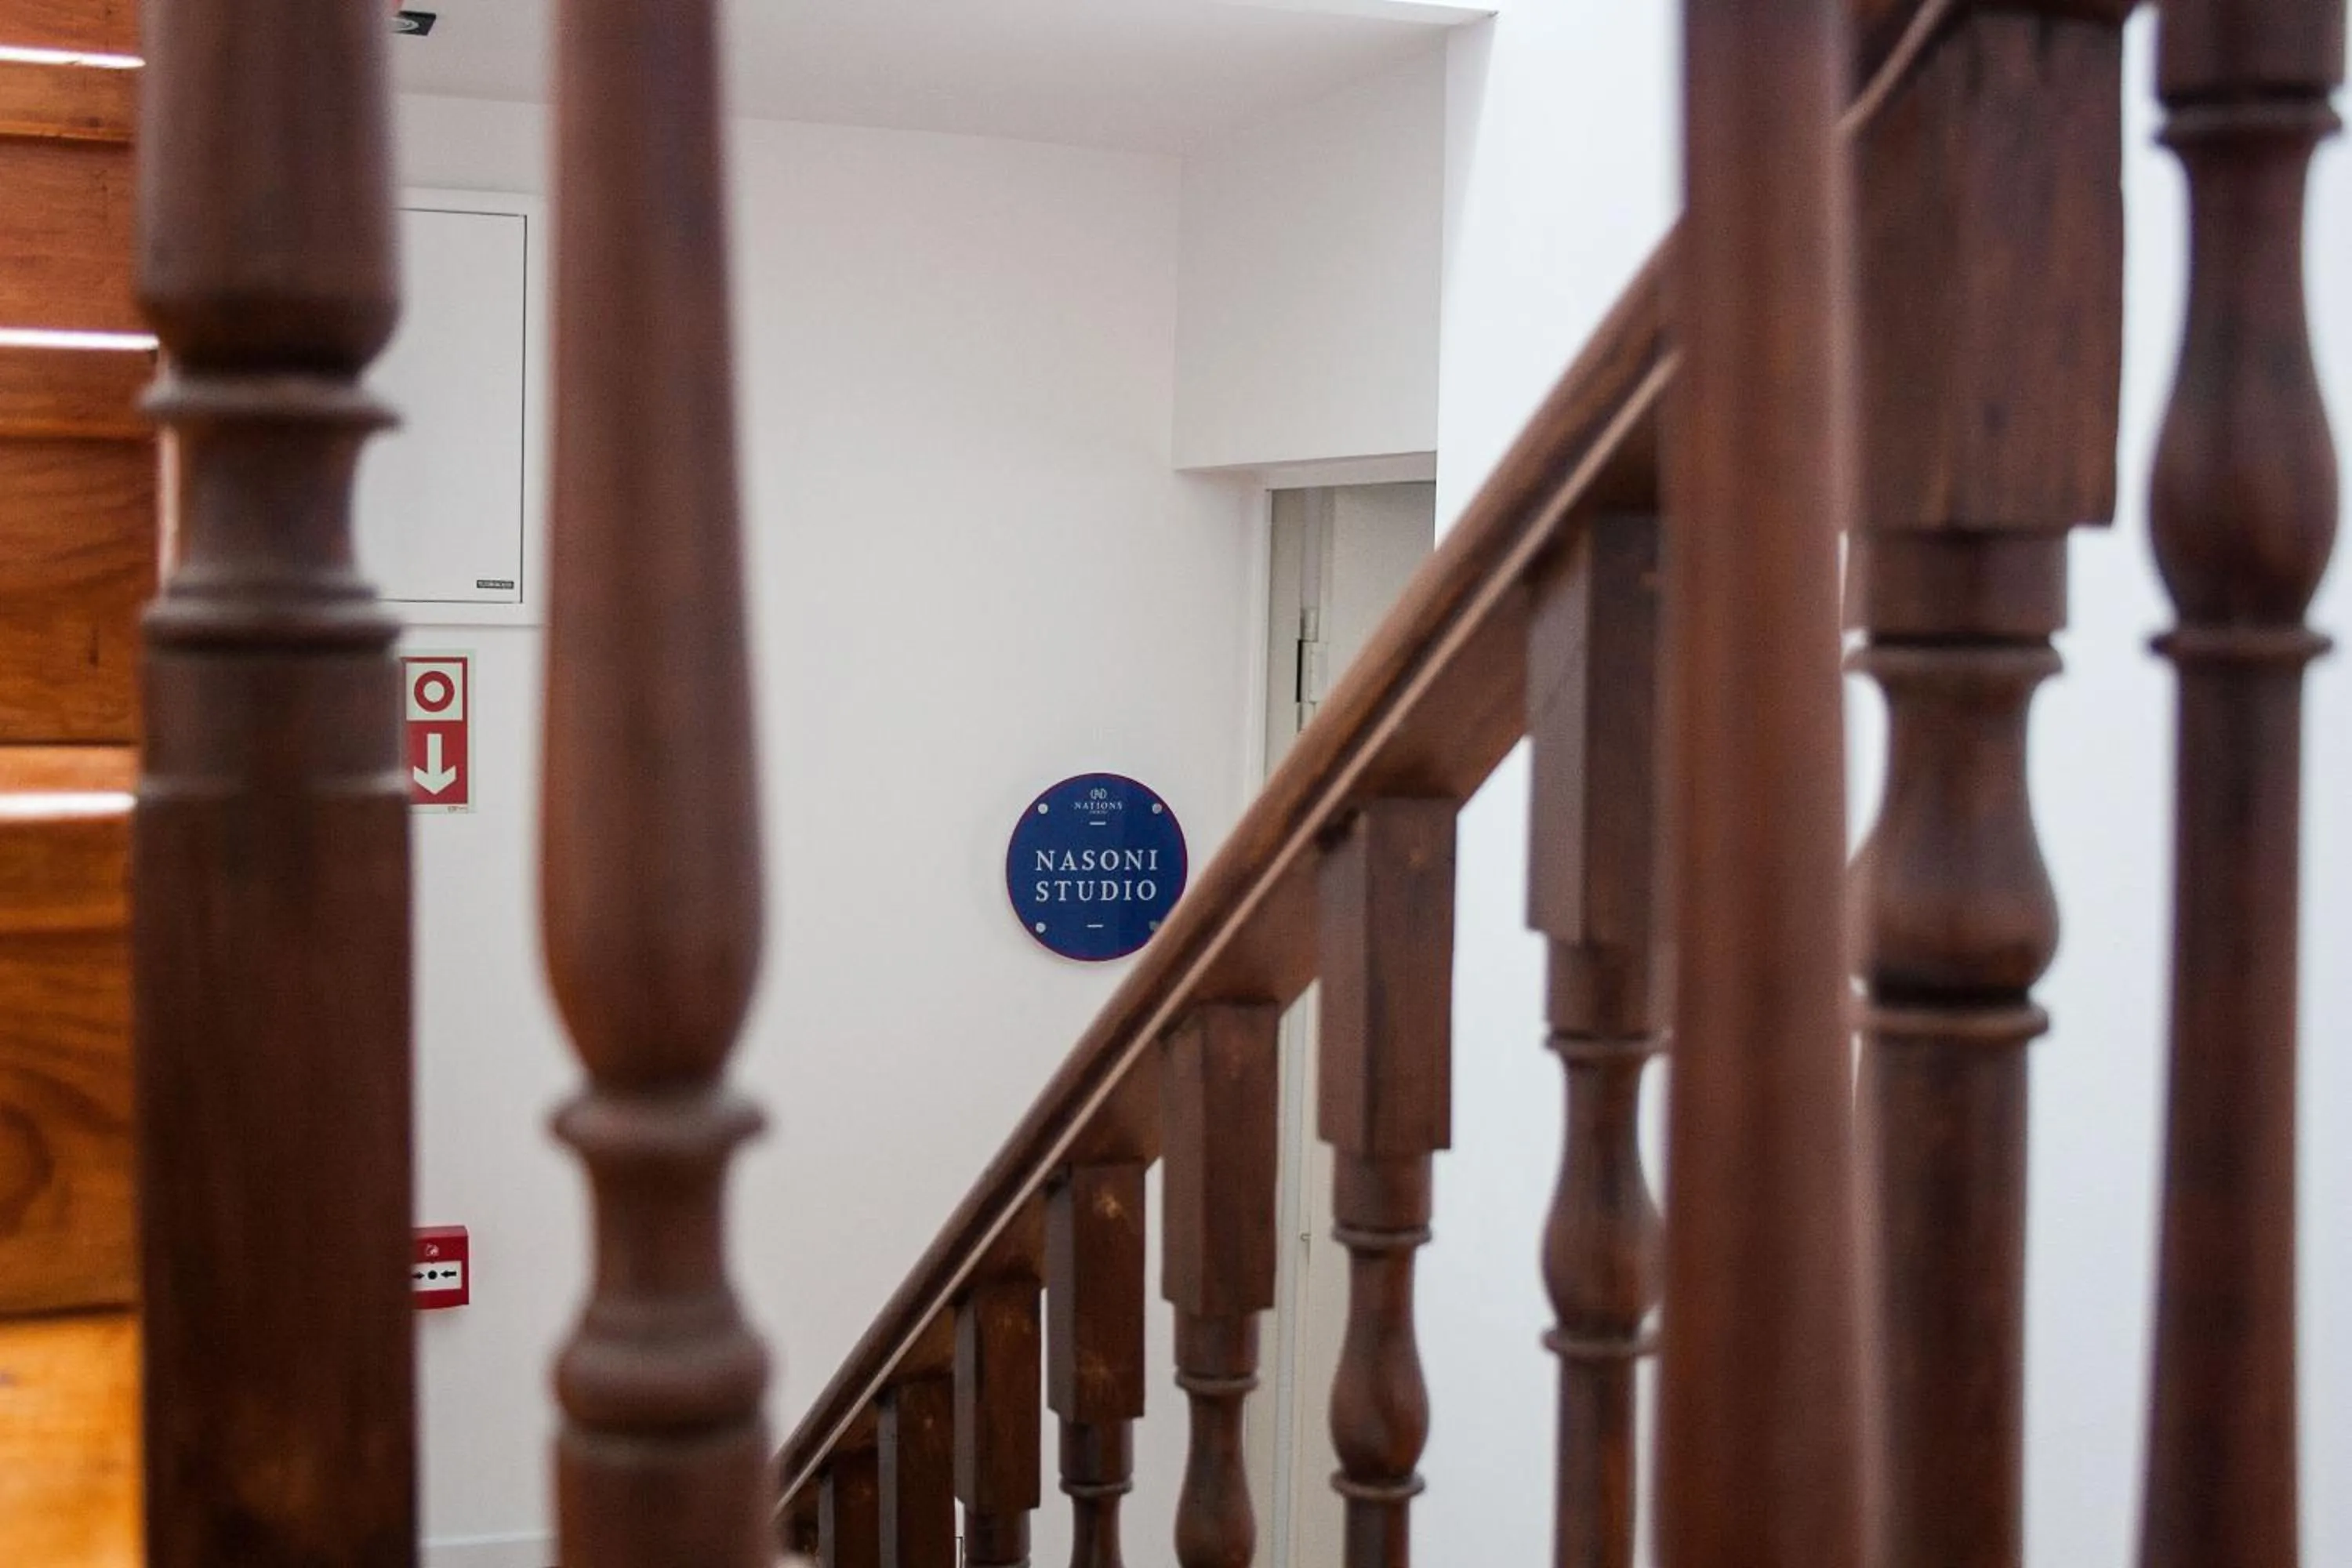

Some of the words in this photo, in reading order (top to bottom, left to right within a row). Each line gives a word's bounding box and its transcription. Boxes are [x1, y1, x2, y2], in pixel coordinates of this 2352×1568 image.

[1073, 801, 1123, 811] NATIONS
[1036, 849, 1159, 871] NASONI
[1036, 880, 1157, 902] STUDIO
